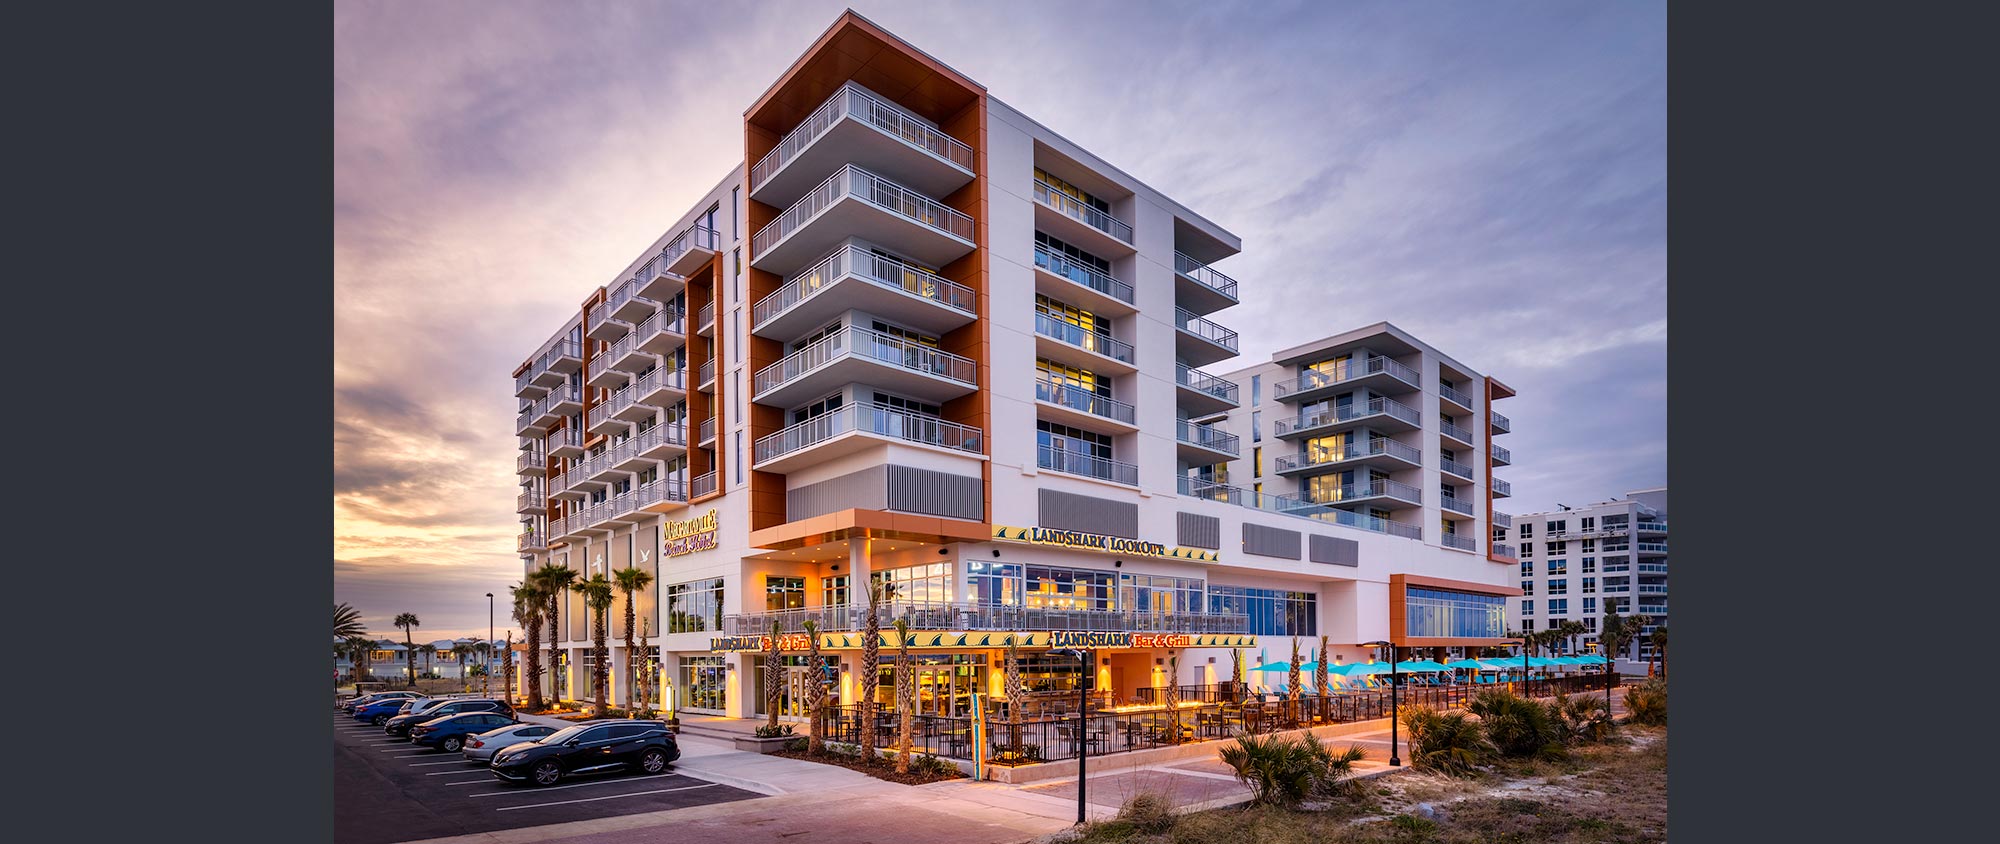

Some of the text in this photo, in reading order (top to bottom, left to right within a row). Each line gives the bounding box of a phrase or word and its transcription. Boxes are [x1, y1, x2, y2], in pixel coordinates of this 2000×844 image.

[1031, 527, 1165, 556] LANDSHARK LOOKOUT
[1053, 631, 1190, 649] LANDSHARK Bar & Grill
